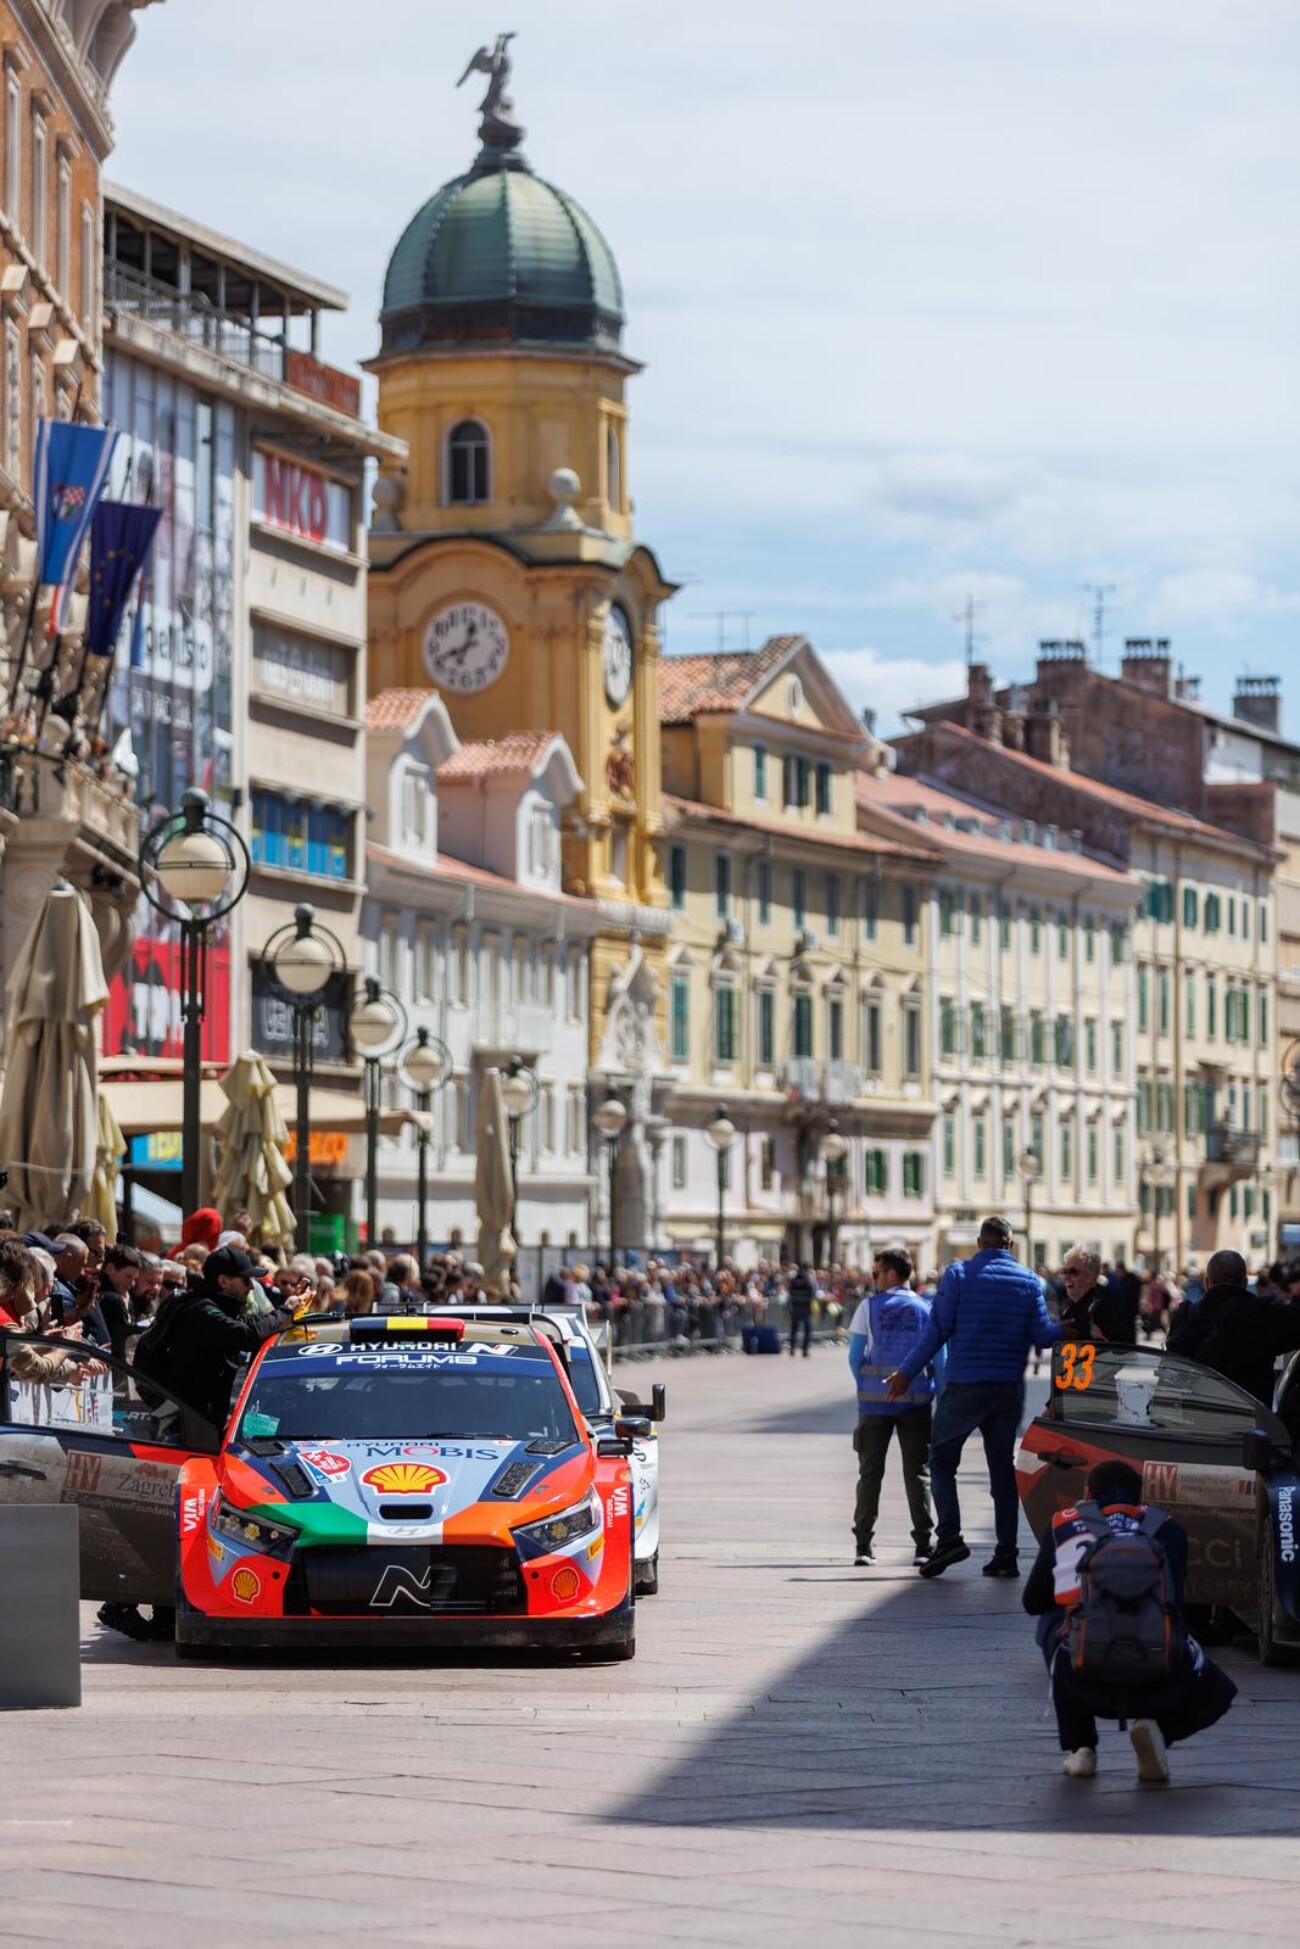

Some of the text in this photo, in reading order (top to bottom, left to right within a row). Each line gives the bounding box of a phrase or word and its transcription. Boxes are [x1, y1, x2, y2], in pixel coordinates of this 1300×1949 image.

[336, 1354, 478, 1365] FORUM8
[350, 1341, 457, 1352] HYUNDAI
[1055, 1343, 1096, 1391] 33
[365, 1445, 499, 1460] MOBIS
[1145, 1463, 1178, 1502] HY
[1278, 1485, 1299, 1563] Panasonic
